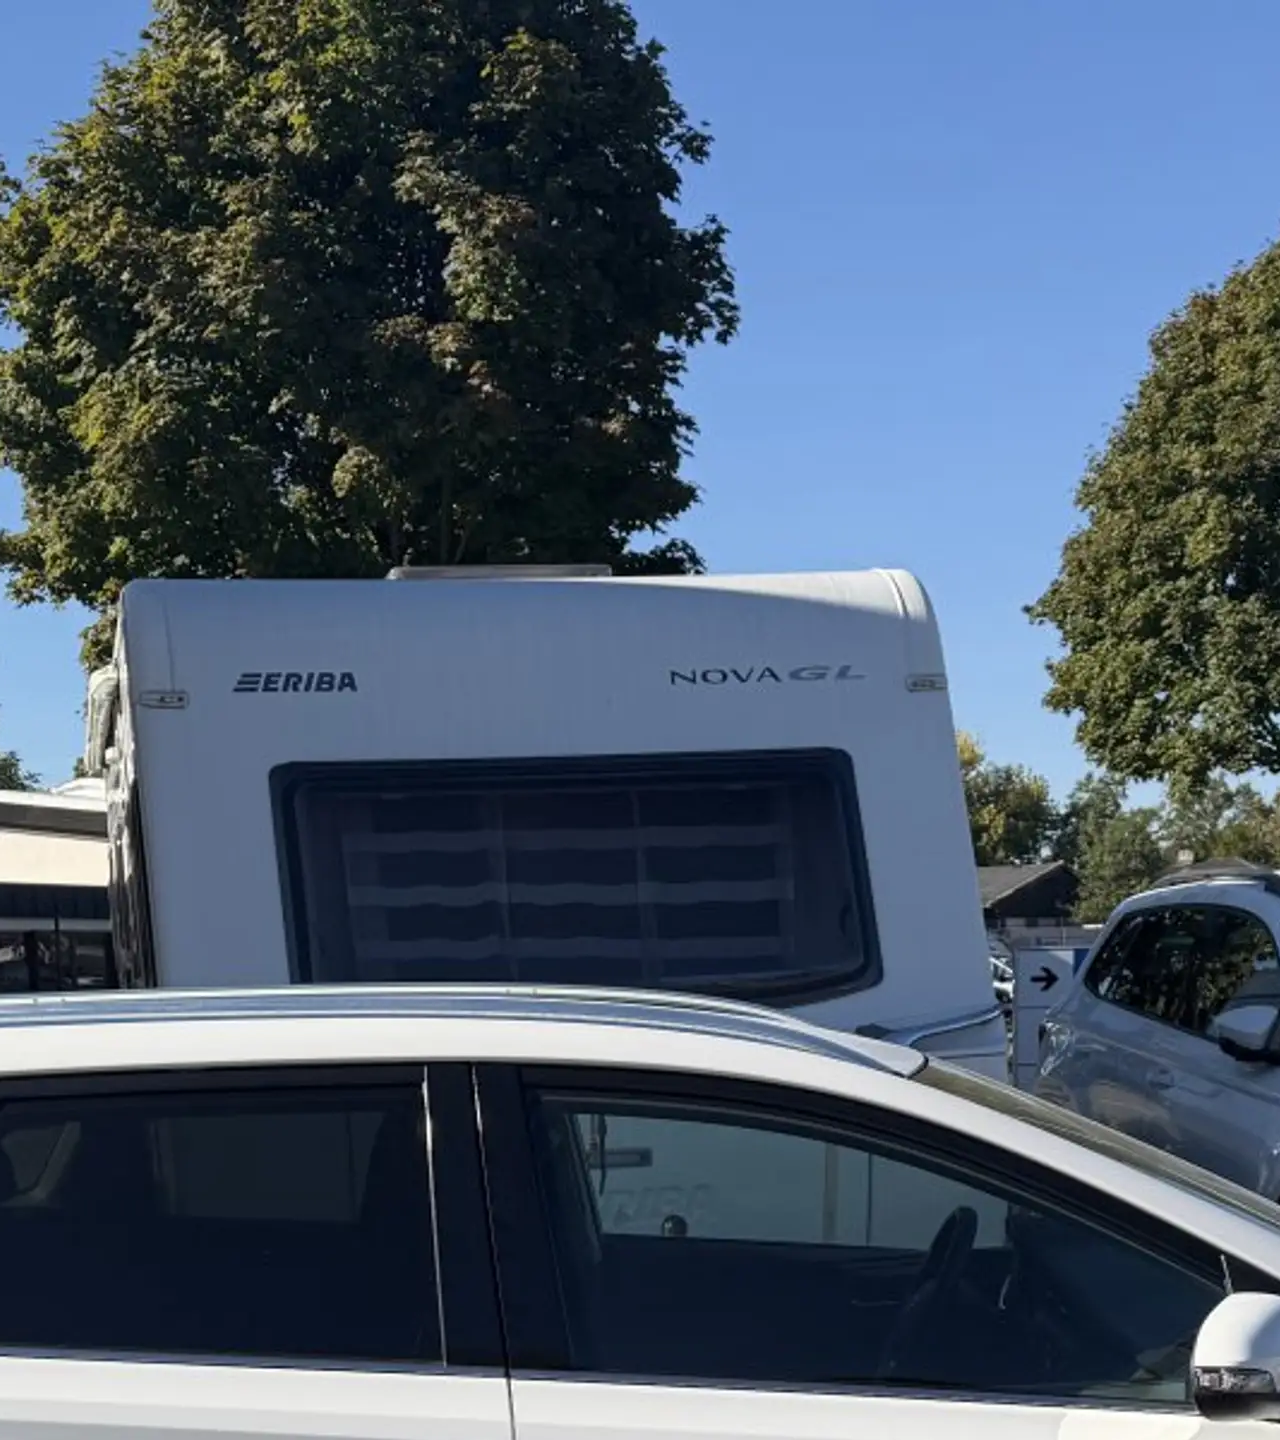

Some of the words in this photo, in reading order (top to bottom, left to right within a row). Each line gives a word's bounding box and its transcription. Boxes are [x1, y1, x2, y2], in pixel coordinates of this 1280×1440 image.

[233, 671, 358, 692] ERIBA
[670, 666, 782, 685] NOVA
[788, 665, 868, 681] GL
